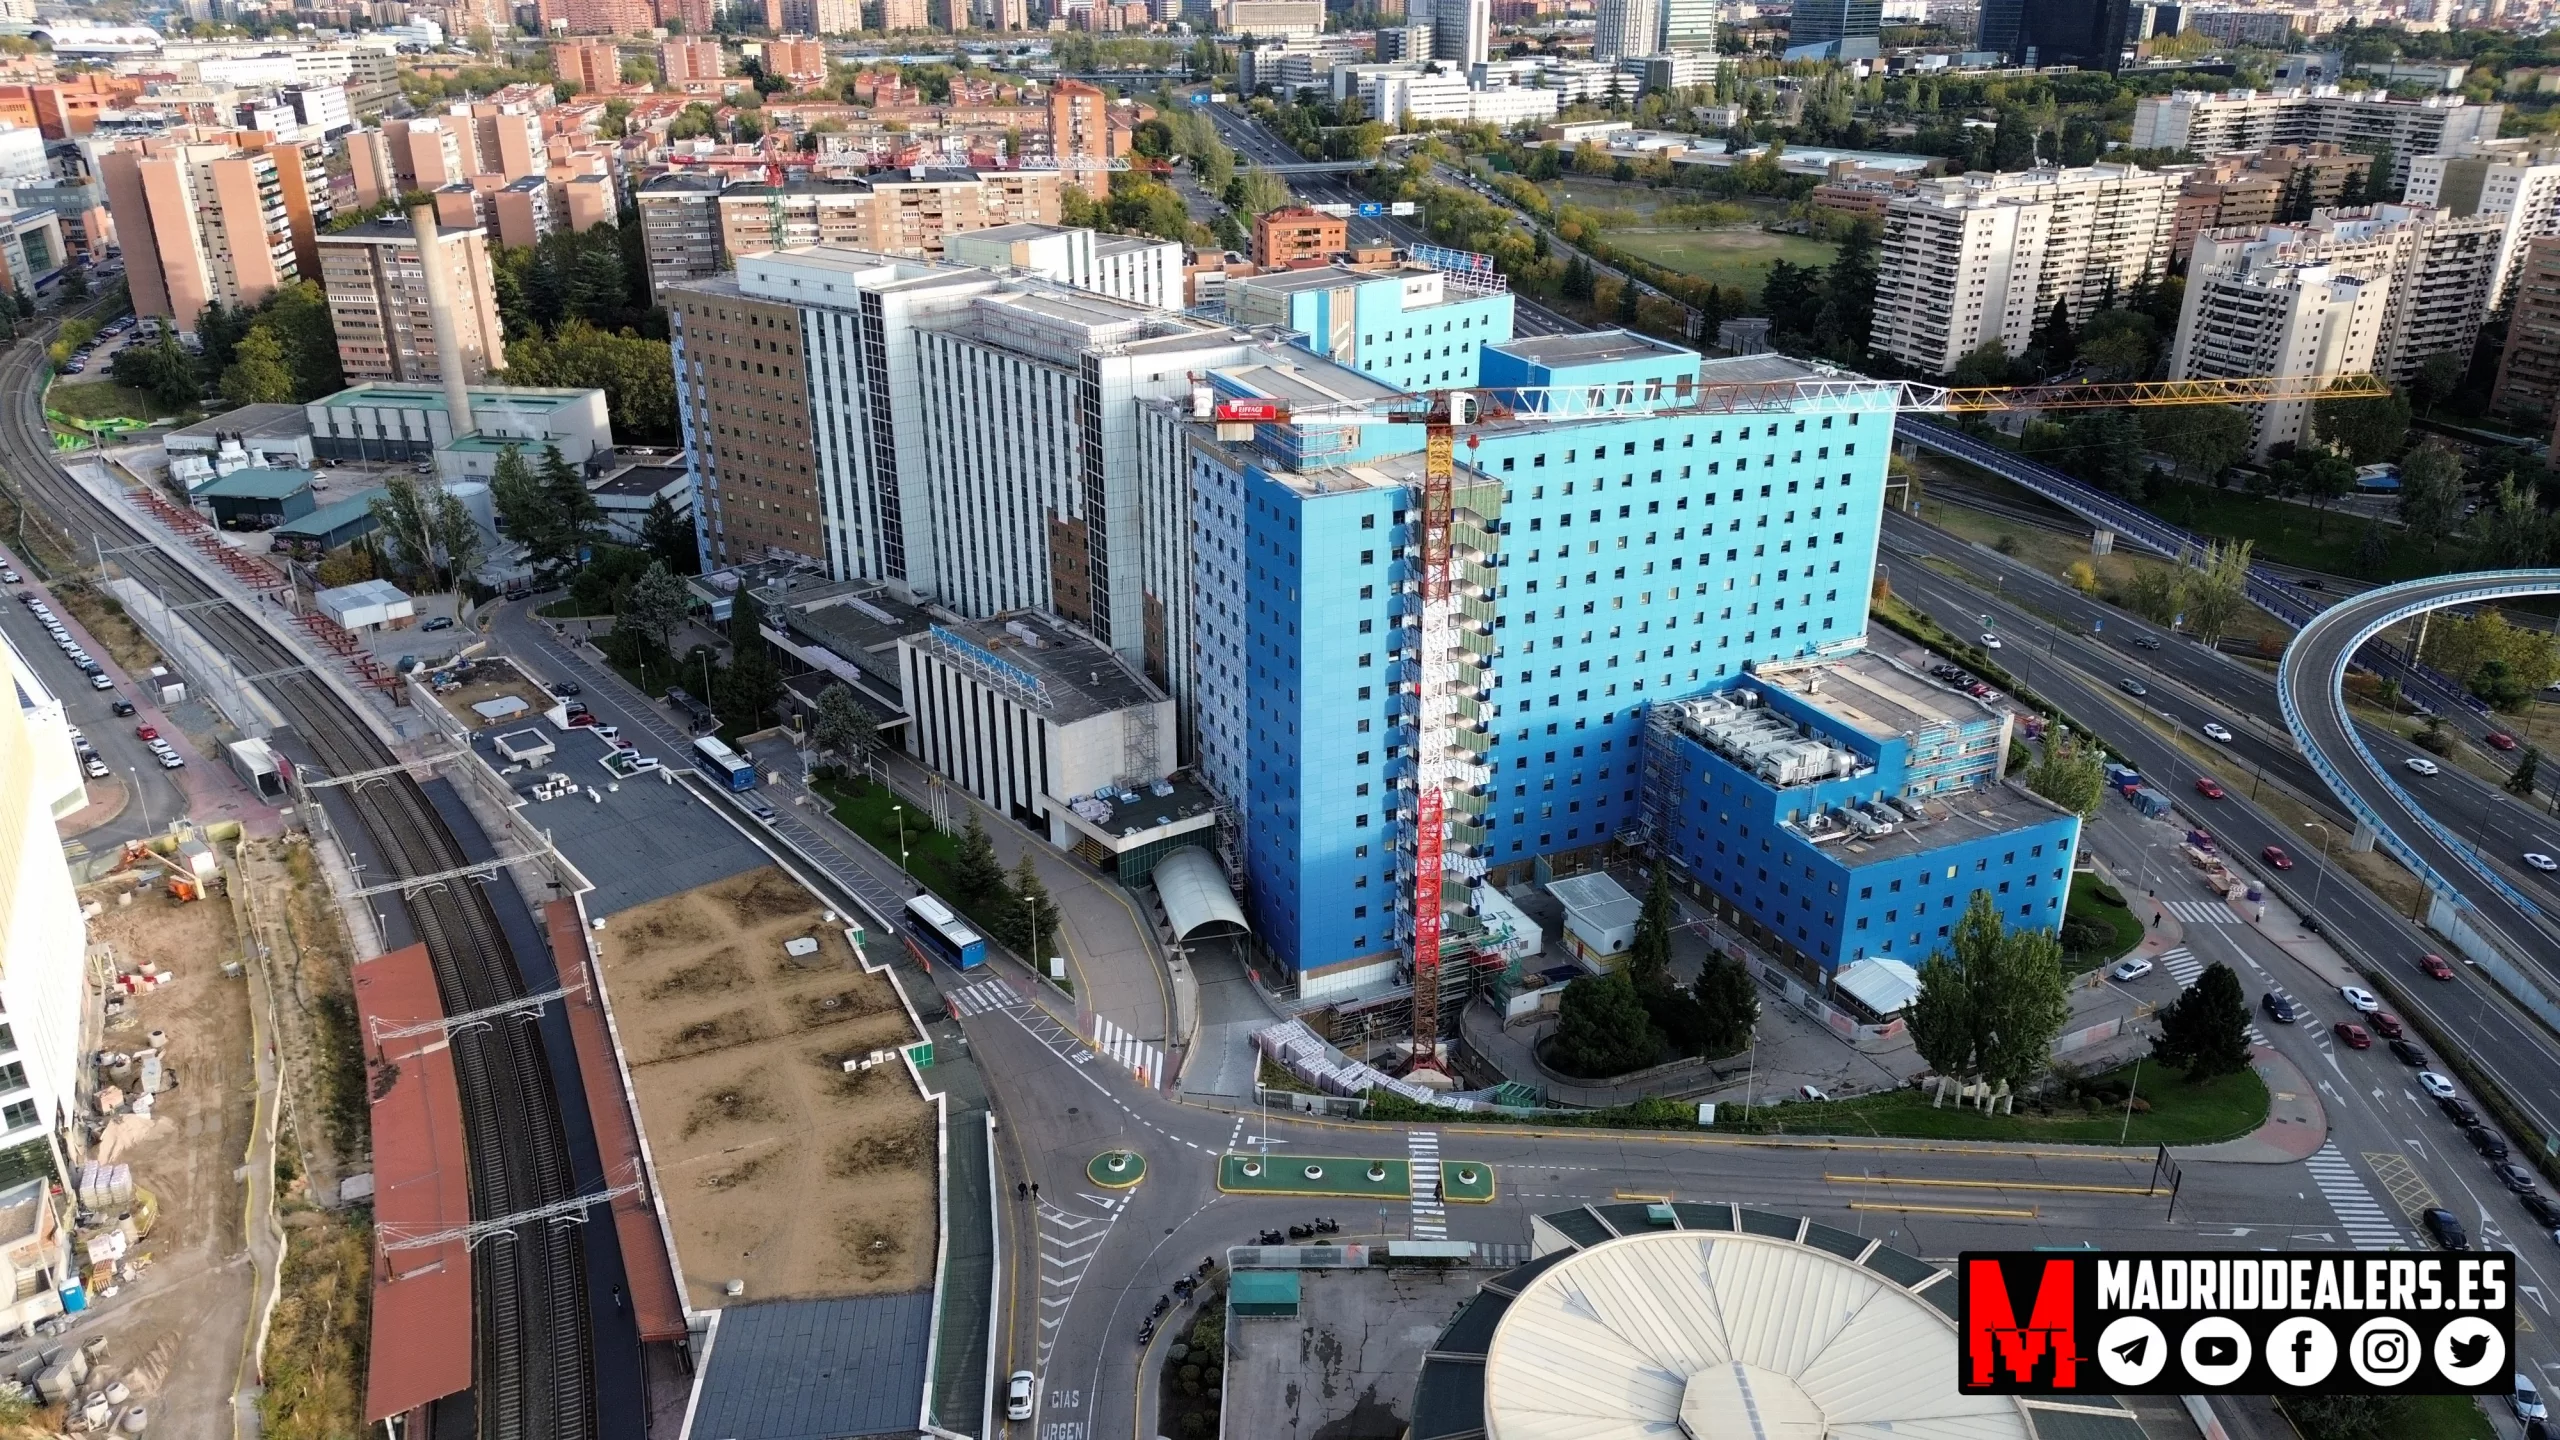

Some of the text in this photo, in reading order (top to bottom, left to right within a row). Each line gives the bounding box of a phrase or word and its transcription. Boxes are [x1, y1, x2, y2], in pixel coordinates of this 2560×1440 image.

[1071, 1049, 1095, 1064] BUS
[1052, 1390, 1079, 1408] CIAS
[1042, 1422, 1083, 1440] URGEN
